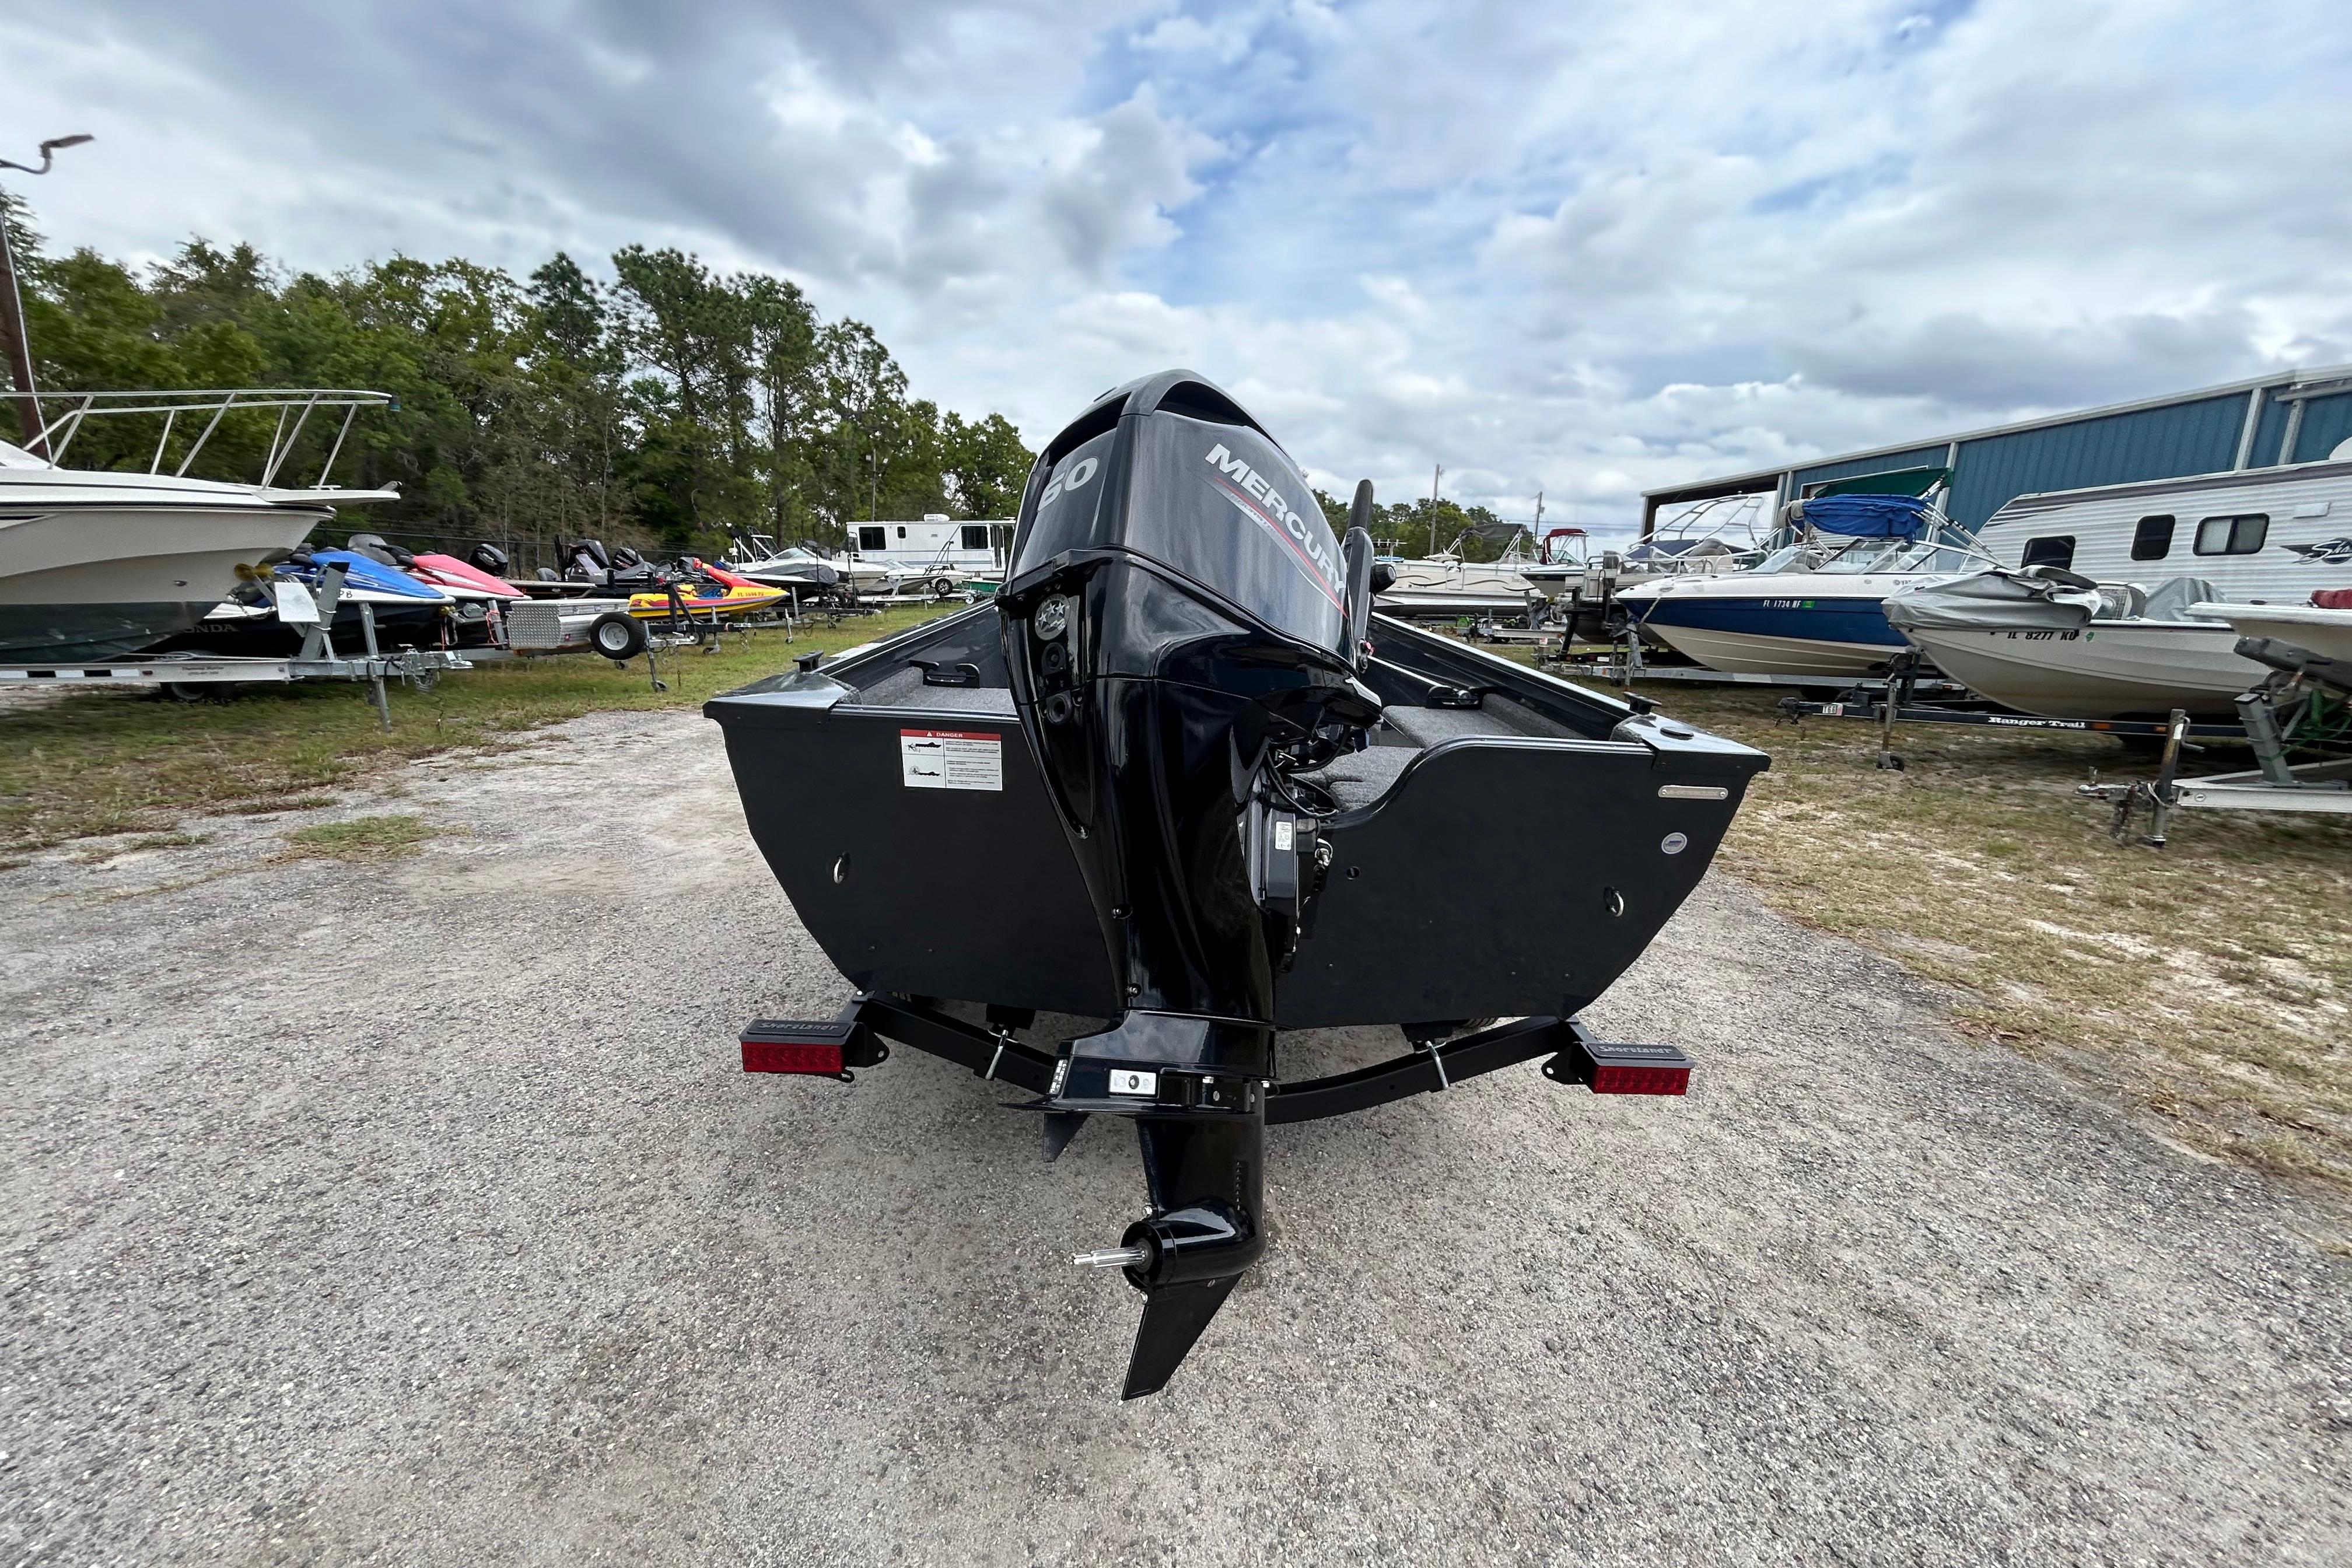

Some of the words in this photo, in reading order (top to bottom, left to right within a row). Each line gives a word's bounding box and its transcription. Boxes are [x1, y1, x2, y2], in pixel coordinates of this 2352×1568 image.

[1205, 443, 1345, 593] MERCURY
[2025, 631, 2054, 640] 8277
[1988, 716, 2046, 726] Ranger
[2048, 720, 2085, 729] Trail
